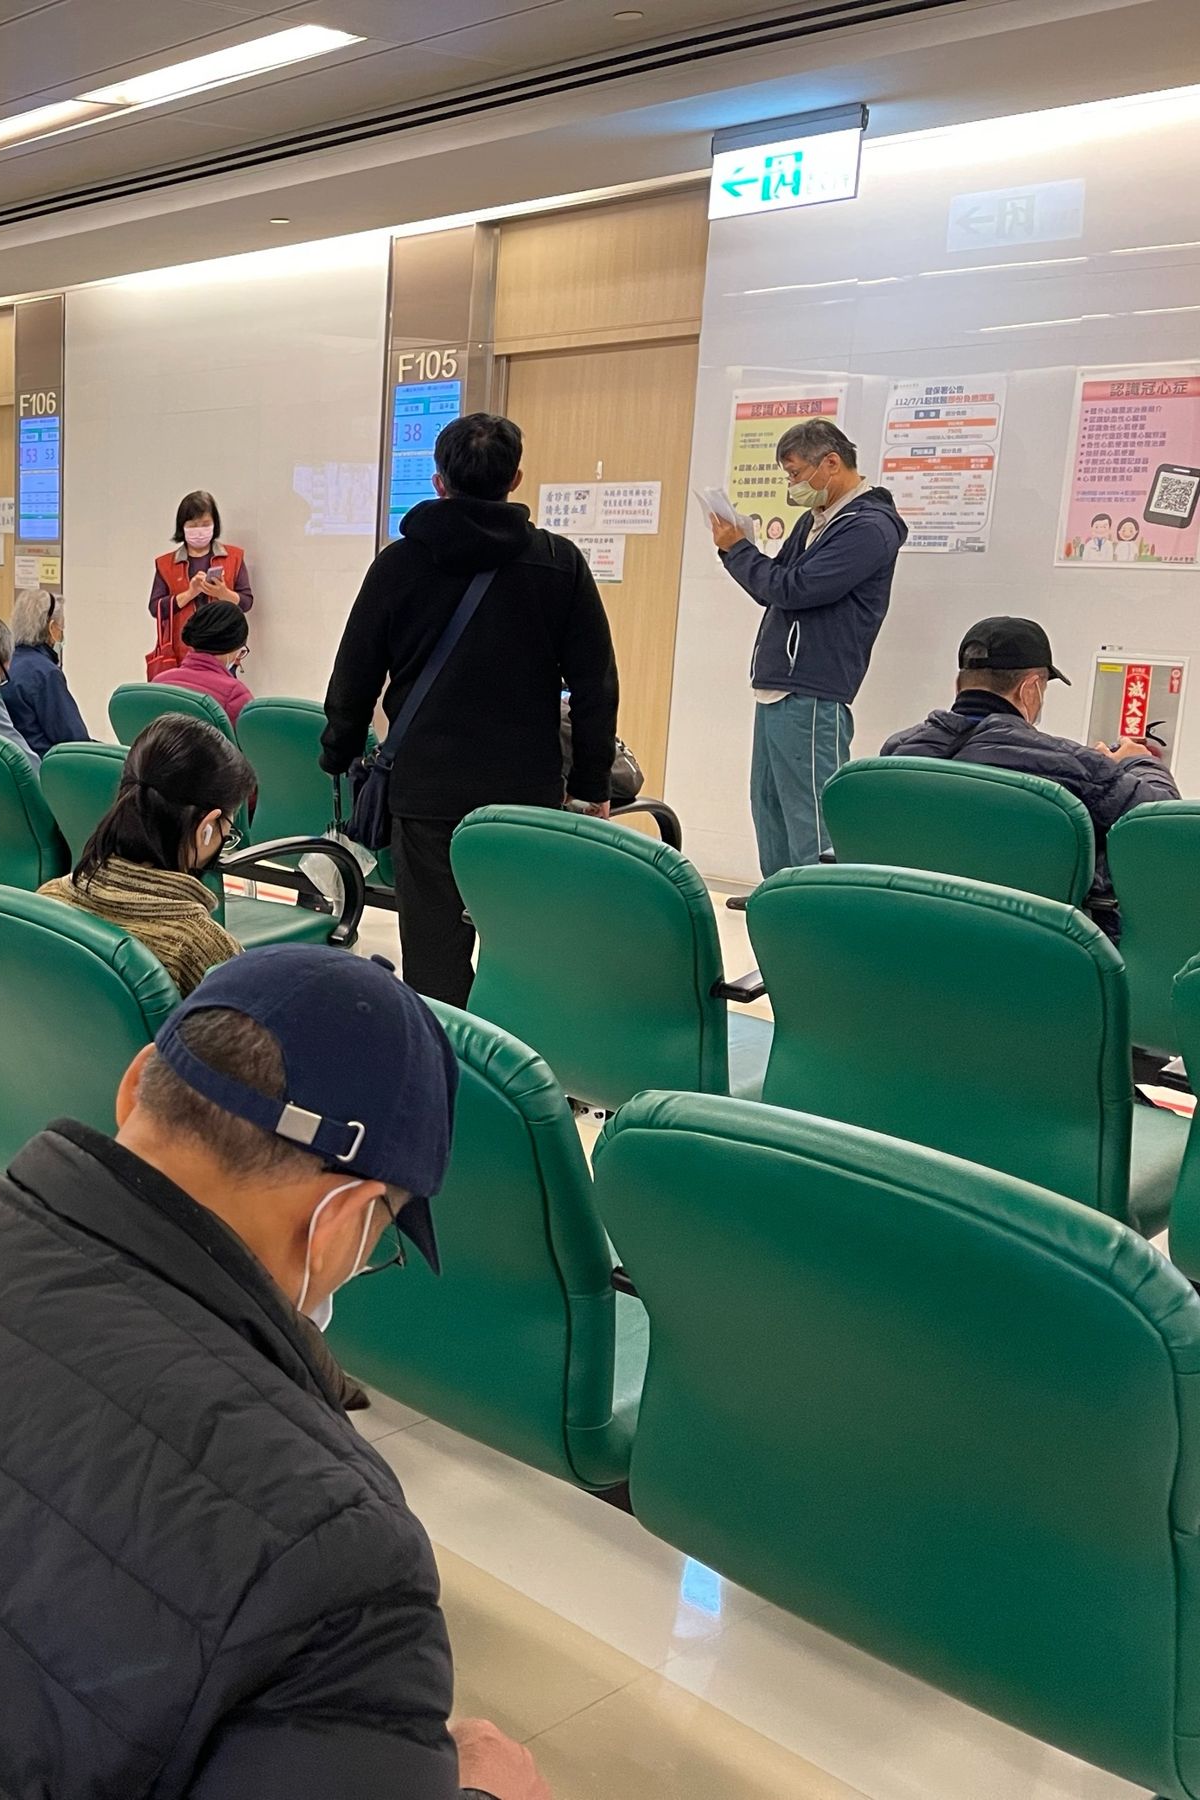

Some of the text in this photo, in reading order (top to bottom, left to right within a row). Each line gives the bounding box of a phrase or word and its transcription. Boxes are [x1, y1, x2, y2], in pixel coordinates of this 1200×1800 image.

[398, 349, 458, 383] F105
[1109, 380, 1189, 397] 認識冠心症
[20, 391, 57, 416] F106
[750, 400, 822, 417] 認識心臟衰竭
[403, 423, 422, 442] 38
[45, 448, 55, 460] 53
[545, 490, 571, 502] 看診前
[545, 504, 588, 516] 請先量血壓
[1124, 680, 1146, 735] 滅火器
